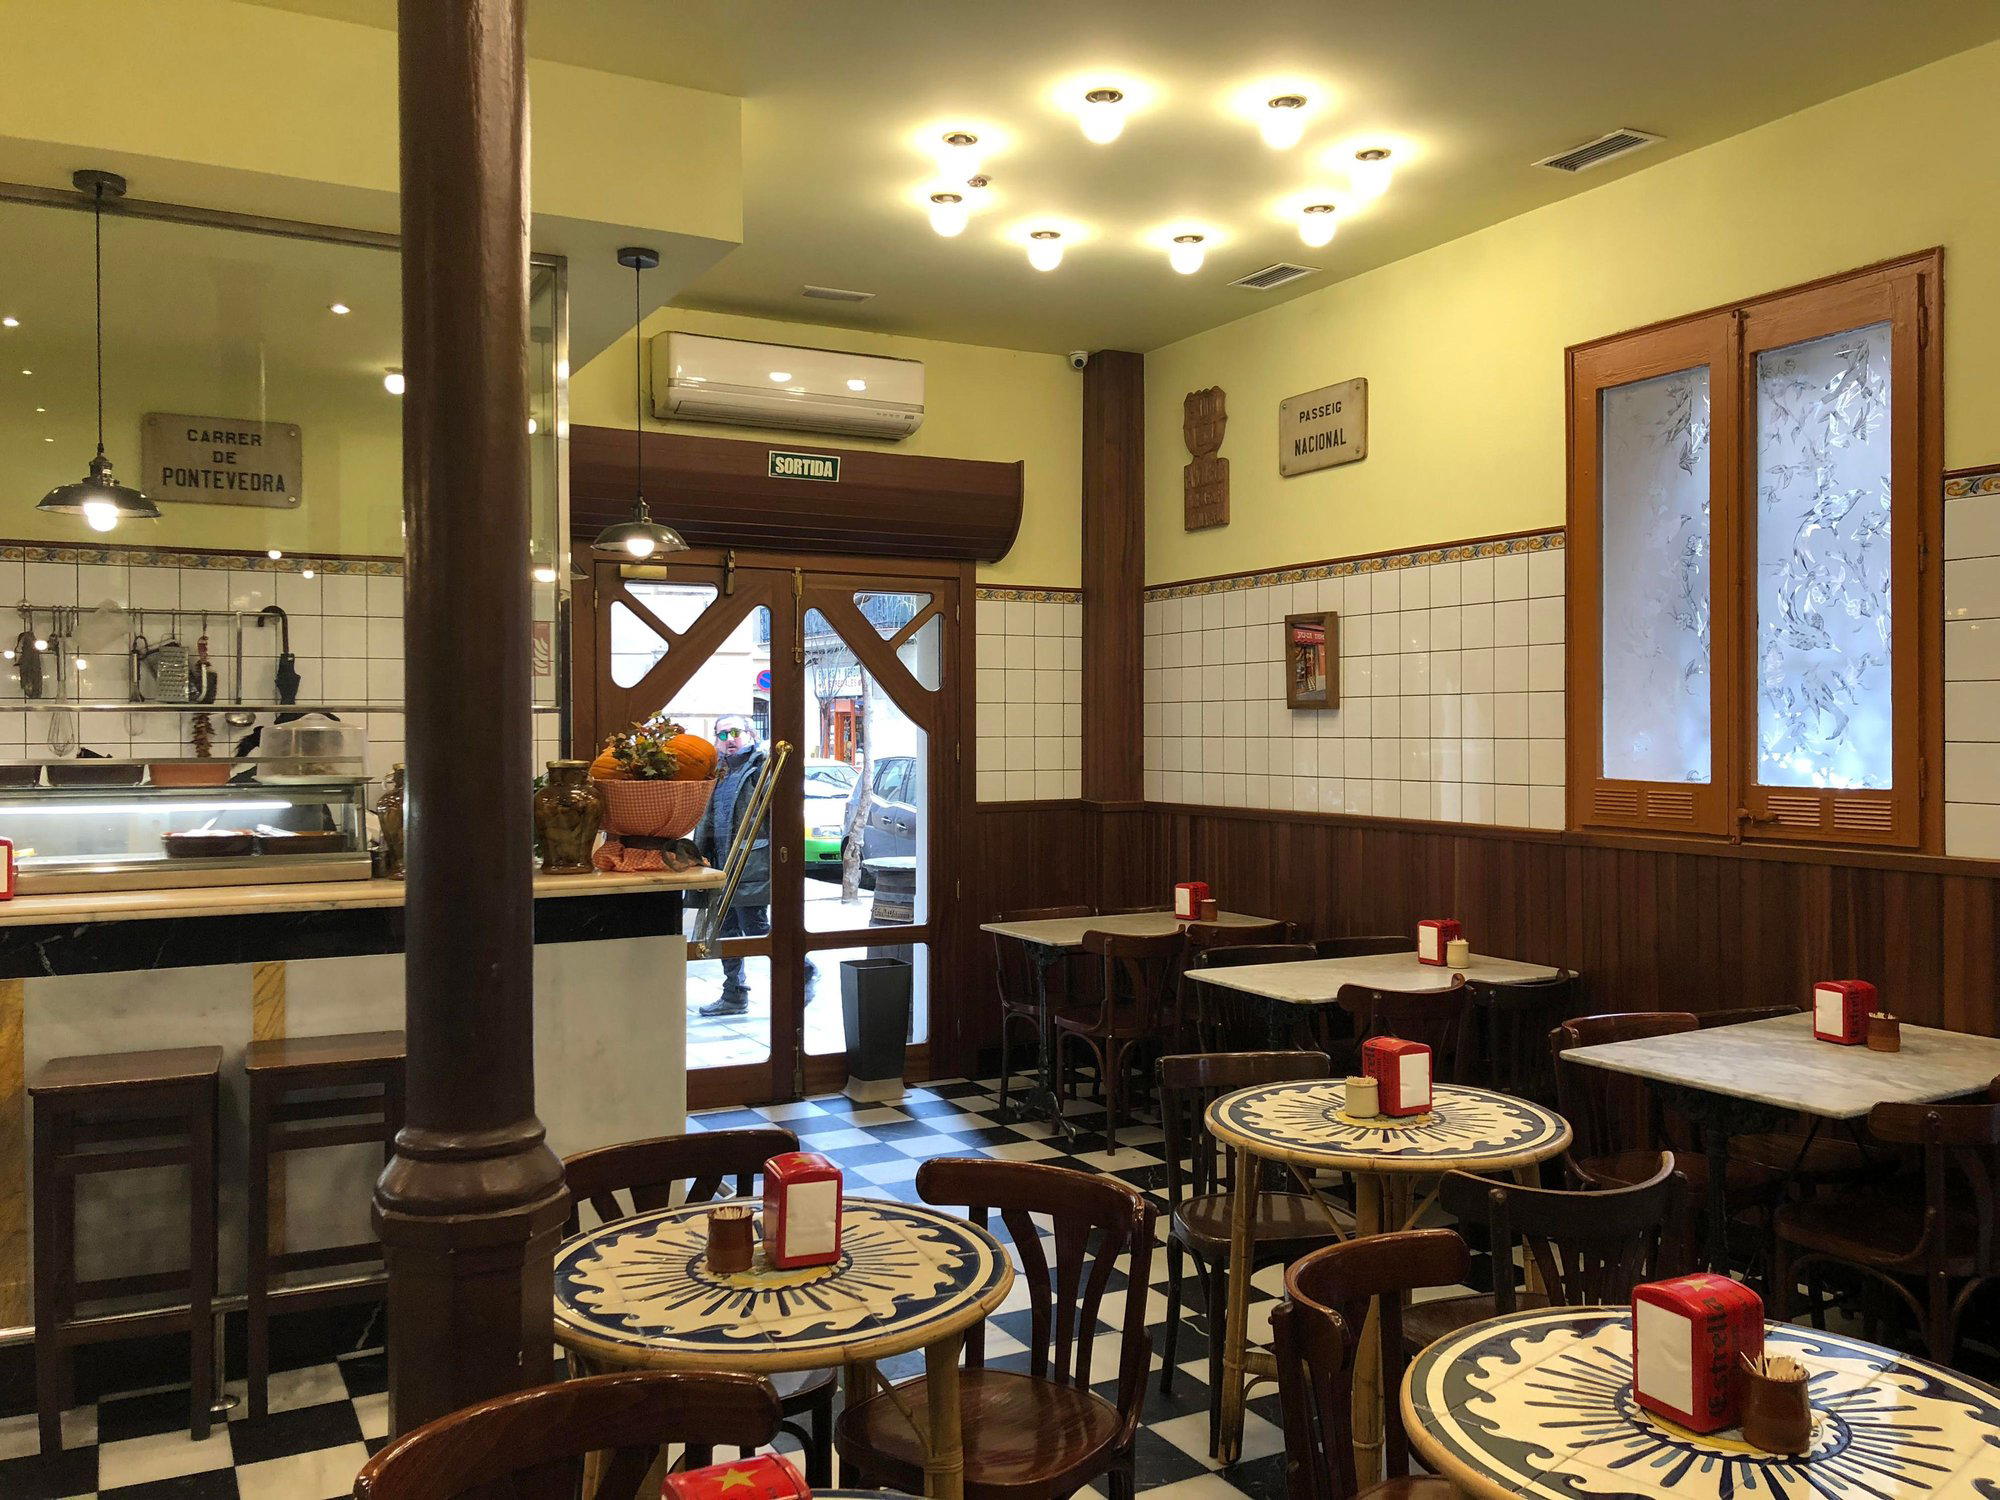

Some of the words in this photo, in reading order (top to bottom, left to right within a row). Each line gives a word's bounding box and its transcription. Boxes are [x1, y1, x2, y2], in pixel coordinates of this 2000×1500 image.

[1299, 401, 1342, 423] PASSEIG
[187, 429, 262, 446] CARRER
[1294, 428, 1347, 457] NACIONAL
[212, 451, 237, 464] DE
[775, 456, 833, 478] SORTIDA
[162, 467, 285, 492] PONTEVEDRA
[1703, 1297, 1728, 1417] Estrella
